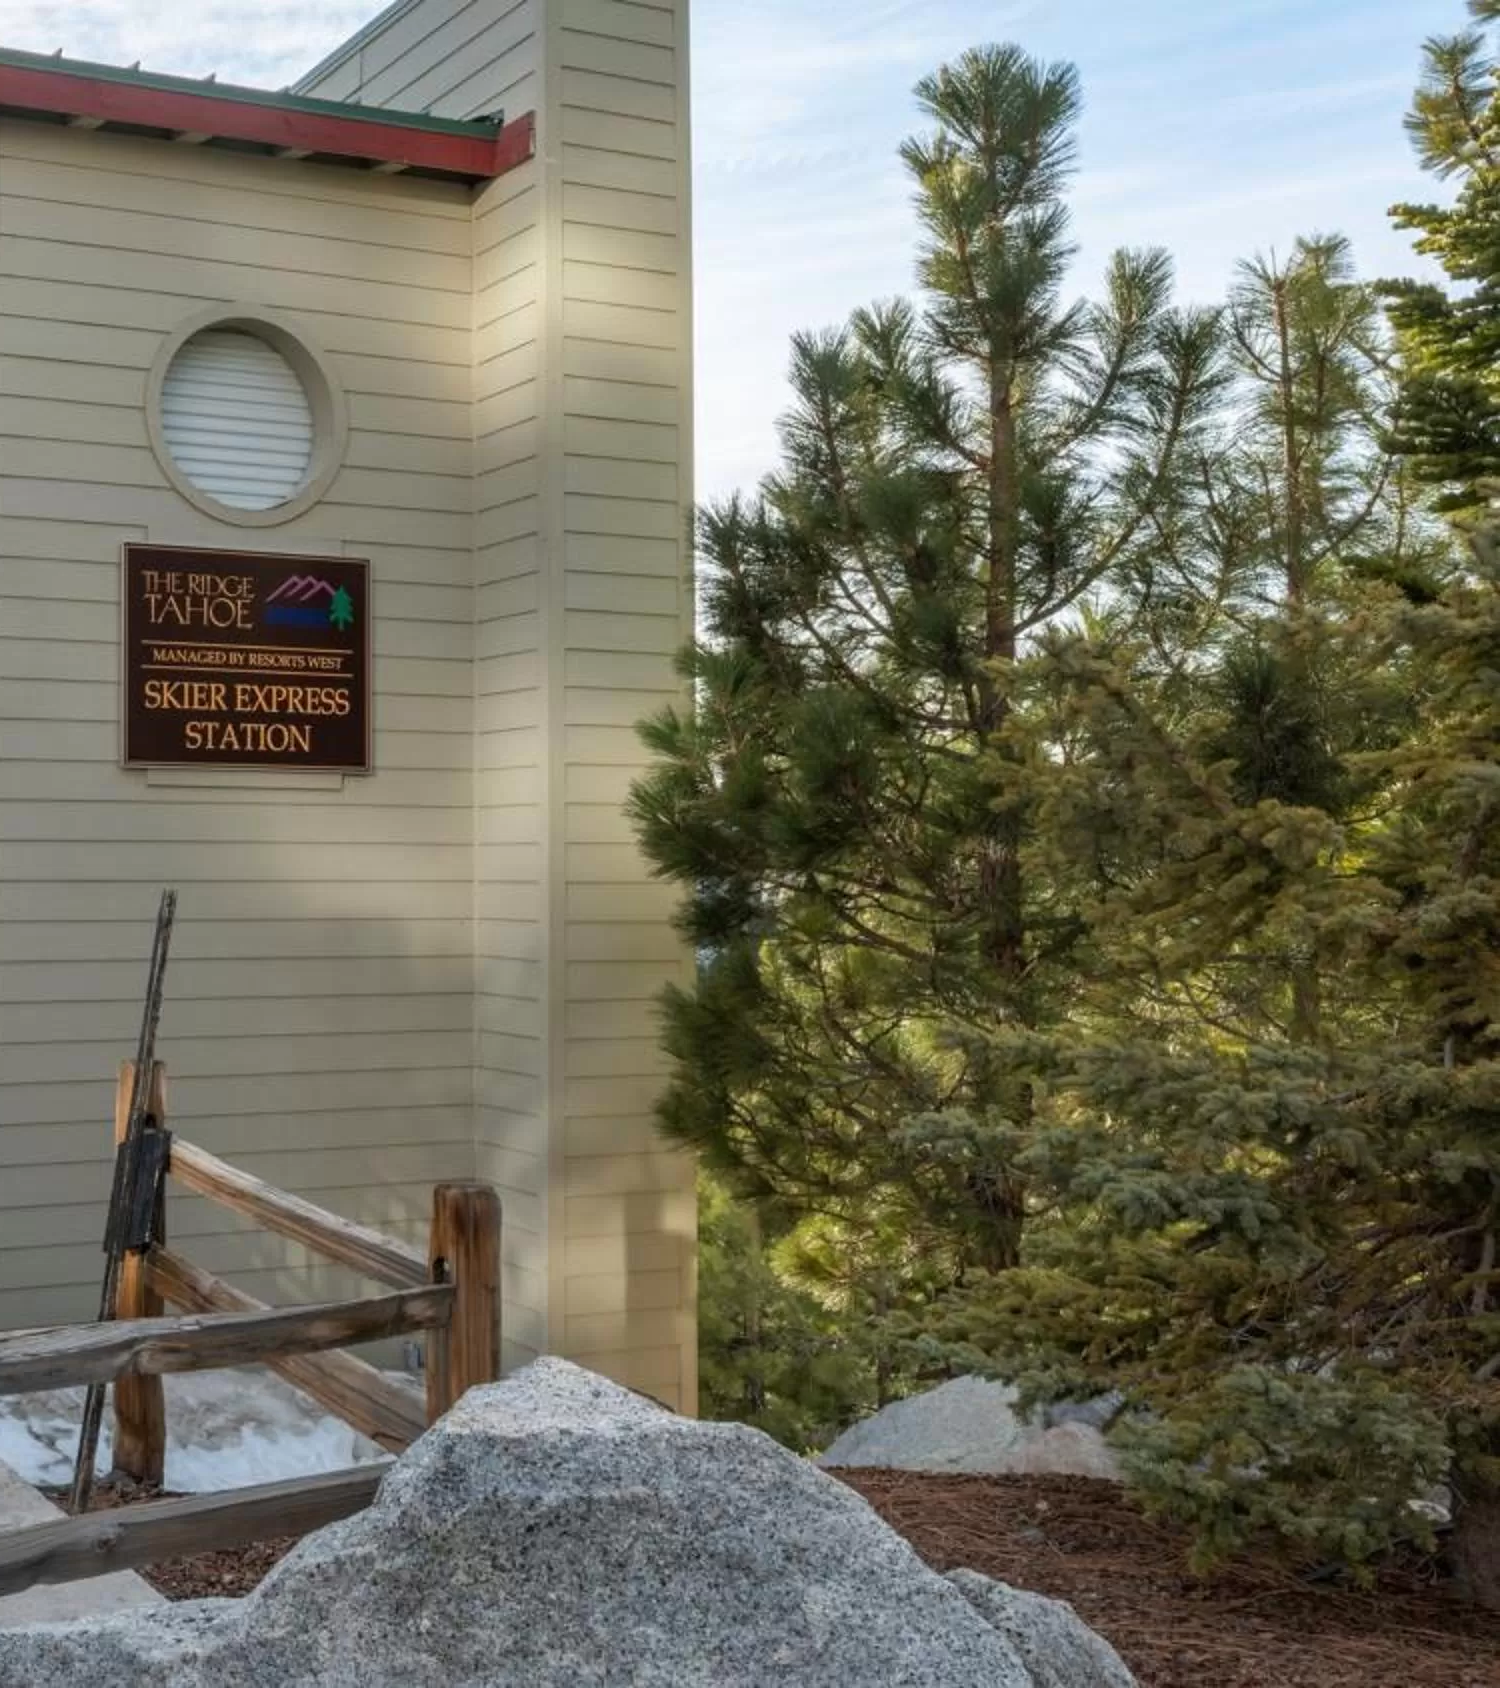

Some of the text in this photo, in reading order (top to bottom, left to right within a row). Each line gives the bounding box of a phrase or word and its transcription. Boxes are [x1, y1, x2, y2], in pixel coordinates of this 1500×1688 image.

[141, 570, 255, 598] THE RIDGE
[143, 594, 253, 628] TAHOE
[153, 649, 342, 670] MANAGED BY RESORTS WEST
[144, 680, 350, 715] SKIER EXPRESS
[185, 721, 312, 752] STATION
